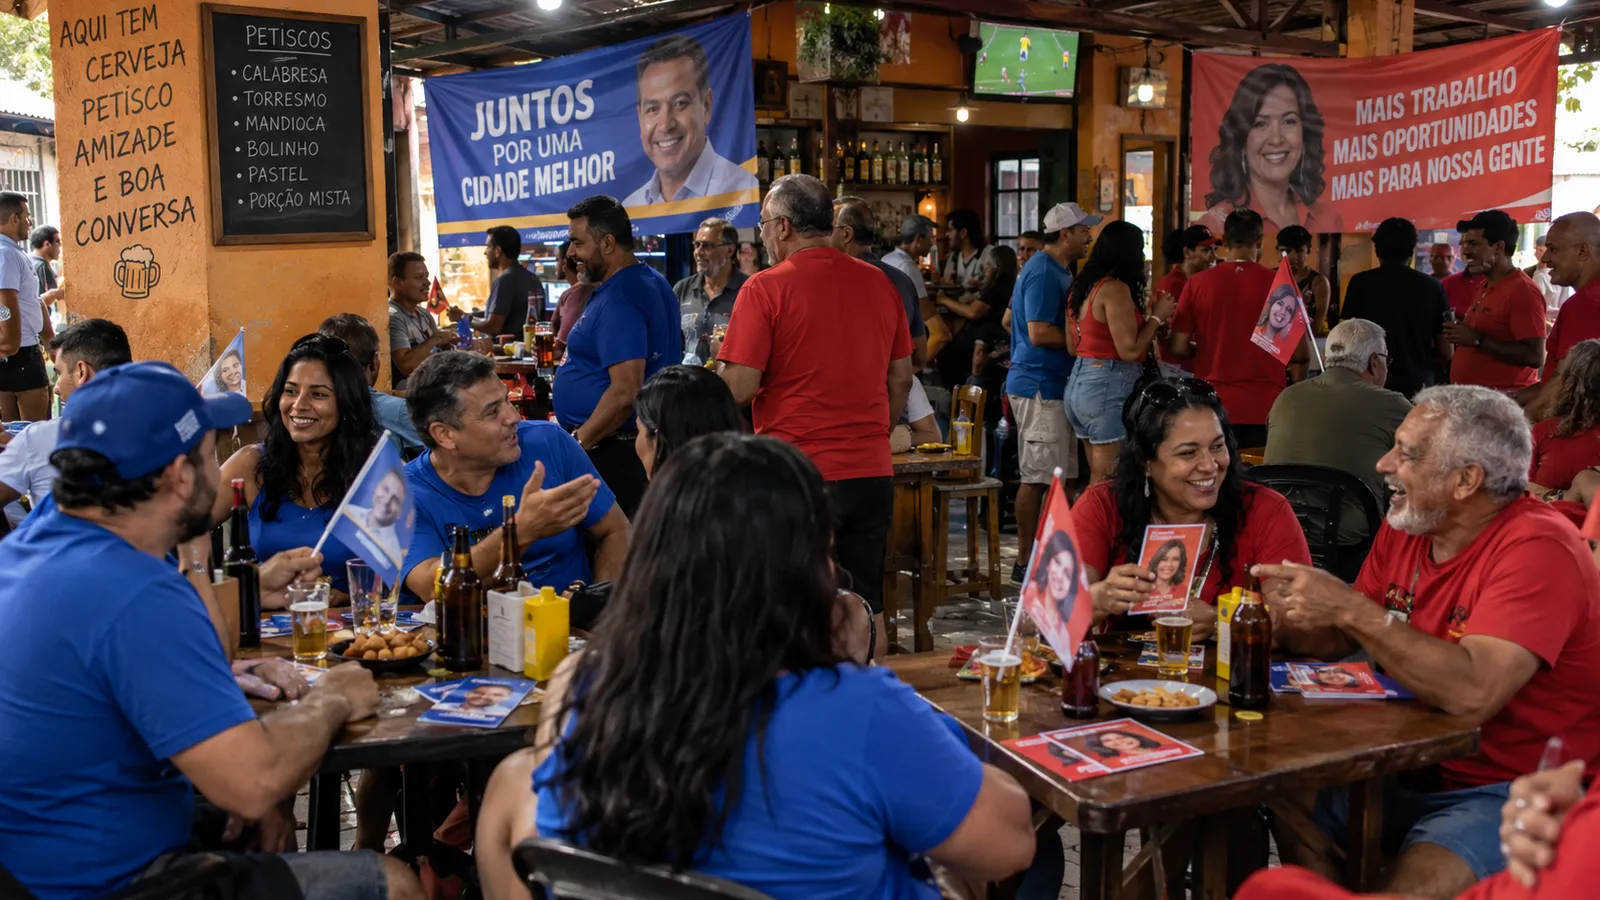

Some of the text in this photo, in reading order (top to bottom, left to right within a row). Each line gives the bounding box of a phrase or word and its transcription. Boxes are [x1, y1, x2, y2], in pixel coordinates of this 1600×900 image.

[59, 4, 158, 48] AQUI TEM
[246, 23, 332, 50] PETISCOS
[86, 39, 186, 83] CERVEJA
[242, 65, 328, 84] CALABRESA
[82, 82, 173, 125] PETISCO
[243, 90, 327, 108] TORRESMO
[470, 79, 595, 141] JUNTOS
[1355, 65, 1517, 126] MAIS TRABALHO
[75, 121, 177, 167] AMIZADE
[246, 116, 326, 132] MANDIOCA
[1333, 98, 1537, 166] MAIS OPORTUNIDADES
[248, 141, 319, 158] BOLINHO
[493, 128, 582, 166] POR UMA
[1331, 135, 1546, 202] MAIS PARA NOSSA GENTE
[94, 163, 165, 203] E BOA
[249, 167, 308, 183] PASTEL
[461, 150, 616, 207] CIDADE MELHOR
[75, 196, 196, 246] CONVERSA
[250, 188, 351, 213] PORÇÃO MISTA
